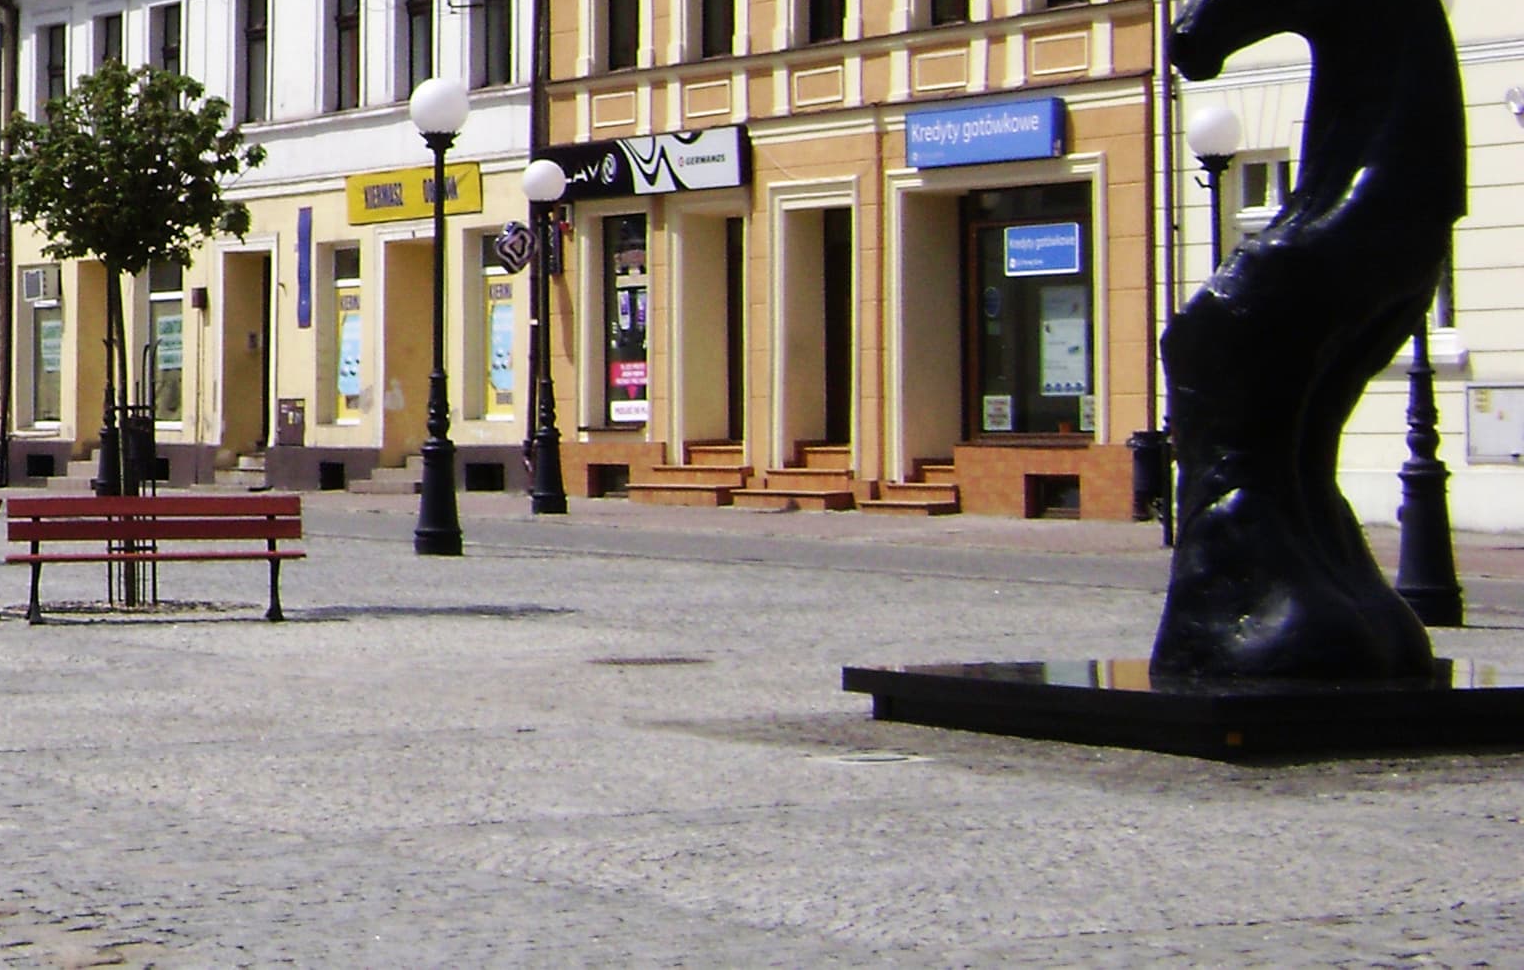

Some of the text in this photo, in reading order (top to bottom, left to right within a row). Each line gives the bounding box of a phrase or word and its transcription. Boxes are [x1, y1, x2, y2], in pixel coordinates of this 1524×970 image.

[911, 112, 1040, 145] Kredyty gotówkowe
[686, 154, 726, 166] GERMANOS
